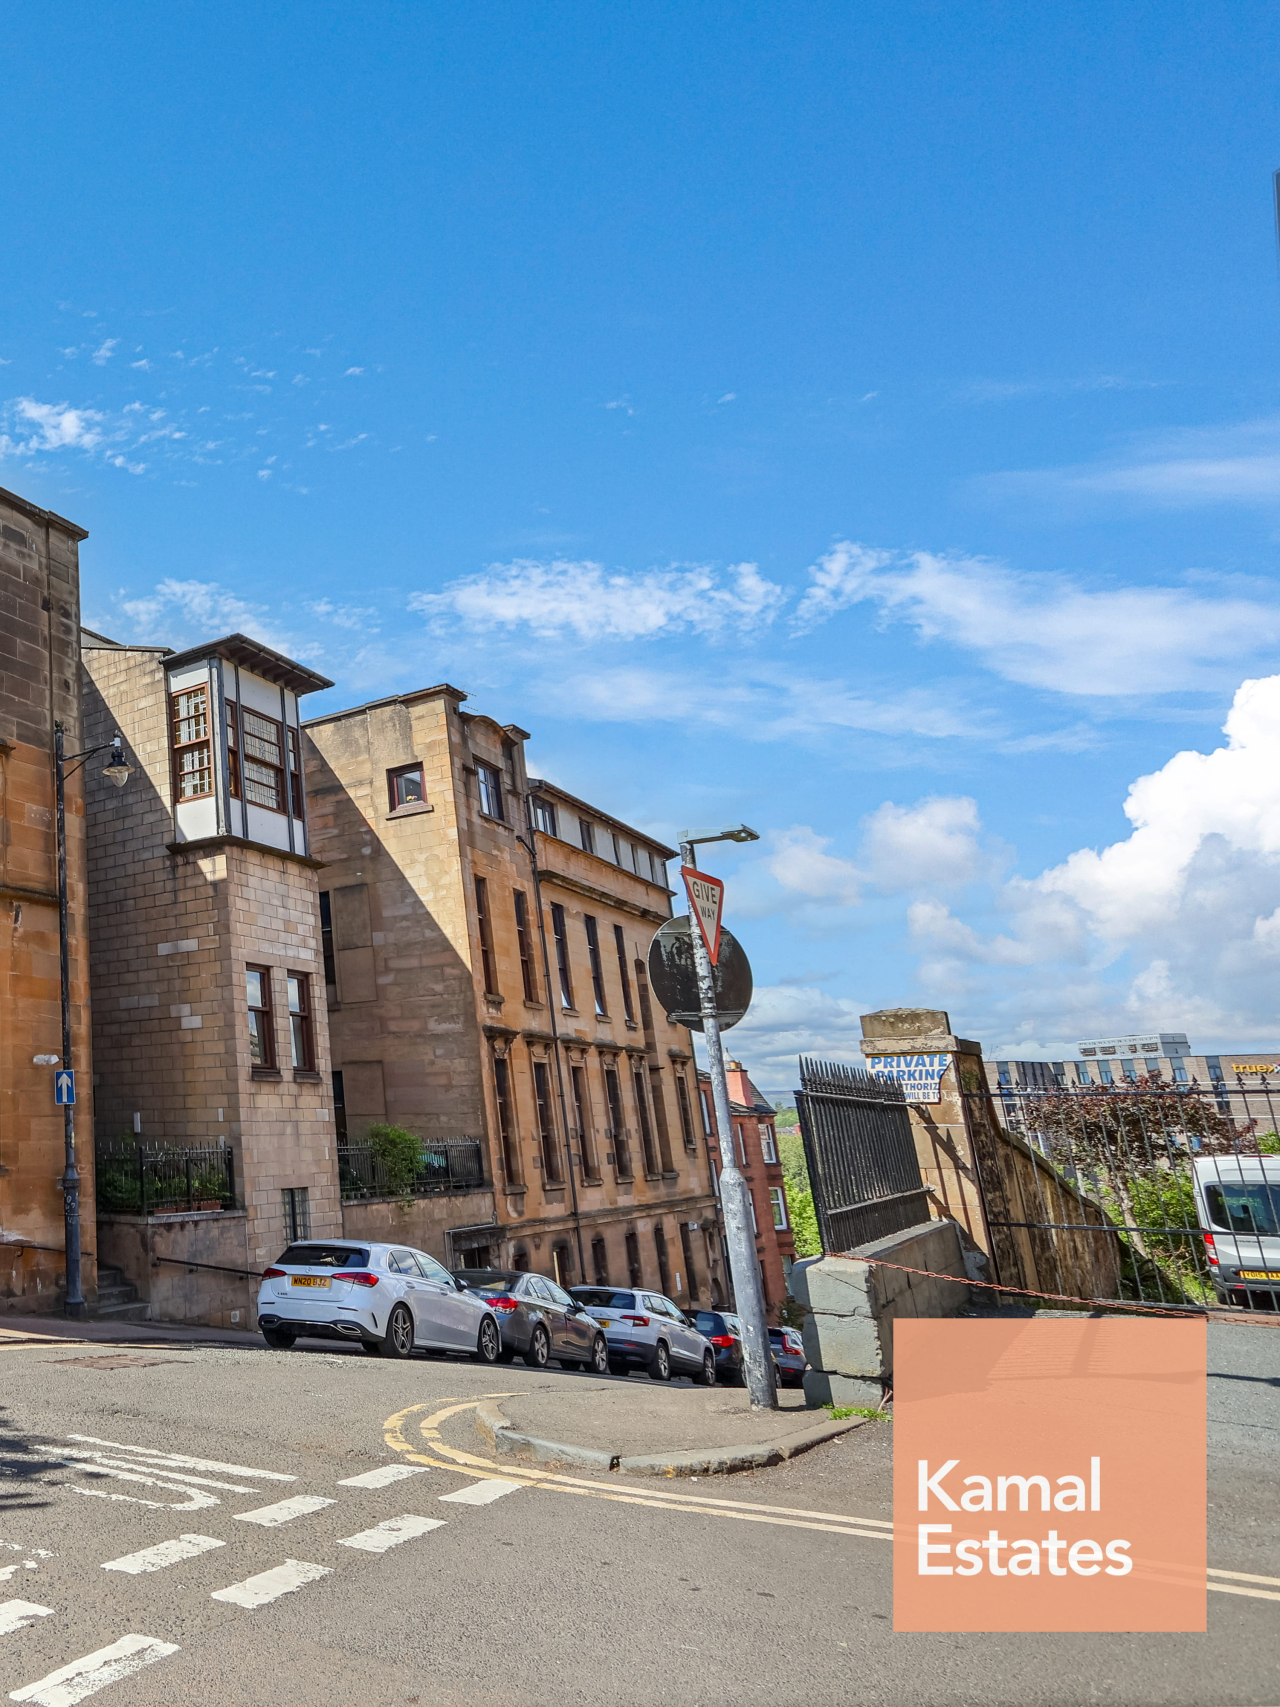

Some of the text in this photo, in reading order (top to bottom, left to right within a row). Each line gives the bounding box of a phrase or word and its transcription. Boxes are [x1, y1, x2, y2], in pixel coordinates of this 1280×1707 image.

[692, 881, 717, 905] GIVE
[700, 905, 715, 920] WAY
[871, 1054, 948, 1068] PRIVATE
[905, 1092, 920, 1100] WILL
[923, 1092, 931, 1100] BE
